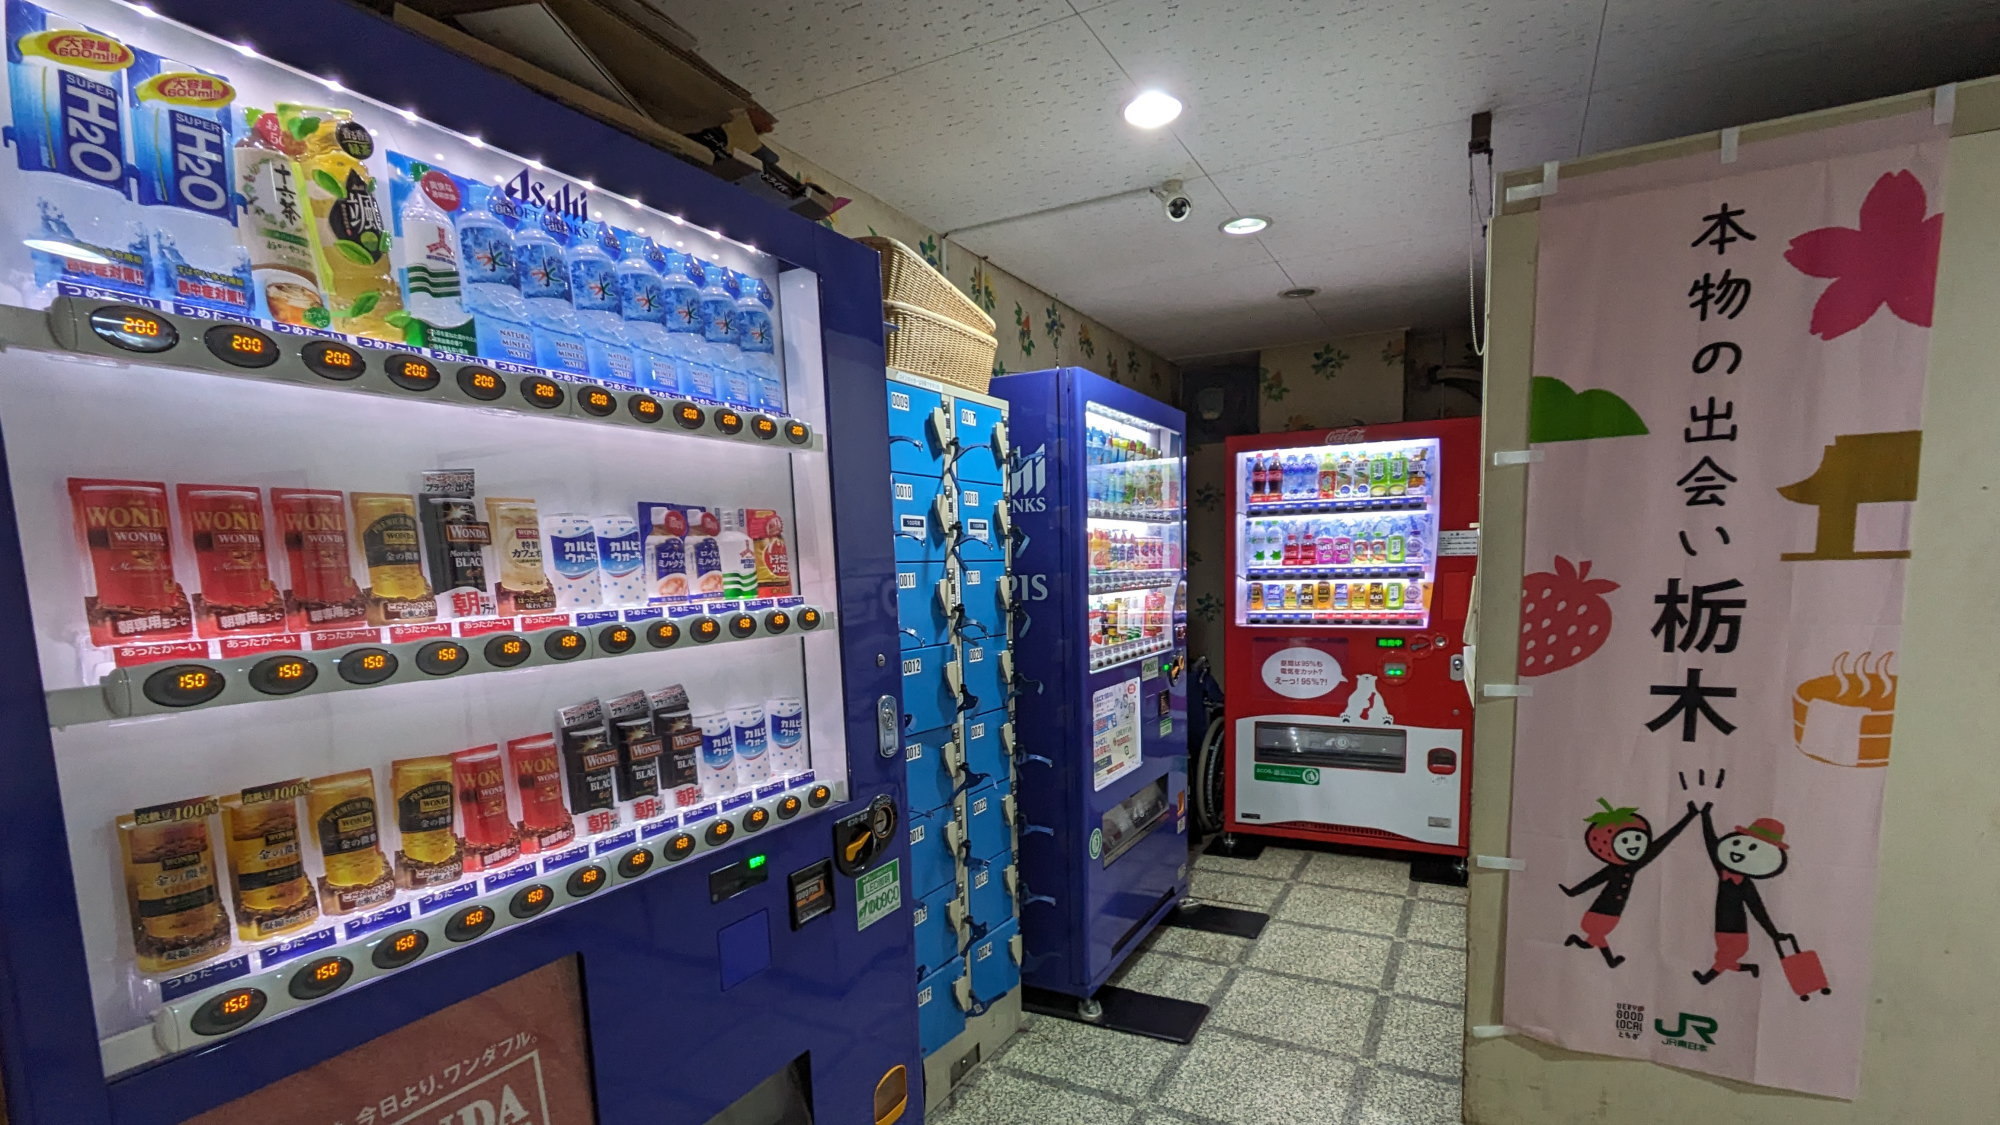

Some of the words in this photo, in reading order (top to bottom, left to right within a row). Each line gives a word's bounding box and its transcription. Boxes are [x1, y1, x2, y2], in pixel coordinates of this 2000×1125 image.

[66, 73, 115, 98] SUPER
[176, 113, 220, 133] SUPER
[66, 84, 122, 181] H2O
[176, 123, 226, 211] H2O
[274, 163, 302, 226] 十六茶
[505, 167, 588, 224] Asahi
[123, 317, 158, 336] 200
[232, 335, 262, 353] 200
[325, 350, 351, 366] 200
[404, 363, 427, 378] 200
[474, 374, 495, 388] 200
[536, 384, 554, 397] 200
[591, 393, 607, 406] 200
[640, 401, 655, 413] 200
[683, 408, 698, 420] 200
[896, 485, 913, 499] 0010
[450, 524, 487, 539] WONDA
[899, 574, 915, 587] 0011
[452, 591, 481, 616] 朝
[614, 630, 627, 642] 150
[660, 626, 673, 637] 150
[504, 641, 520, 654] 150
[562, 635, 577, 647] 150
[364, 655, 384, 669] 150
[438, 648, 456, 661] 150
[969, 649, 983, 662] 0020
[279, 663, 301, 678] 150
[904, 659, 921, 674] 0012
[180, 673, 205, 689] 150
[675, 787, 696, 806] 朝
[634, 799, 656, 820] 朝
[973, 800, 987, 814] 0022
[587, 812, 611, 833] 朝
[676, 838, 689, 849] 150
[632, 852, 645, 865] 150
[583, 870, 597, 882] 150
[528, 889, 543, 903] 150
[466, 910, 483, 925] 150
[396, 935, 415, 951] 150
[317, 962, 338, 979] 150
[225, 994, 249, 1013] 150
[1616, 1010, 1644, 1022] GOOD
[1654, 1012, 1718, 1045] JR
